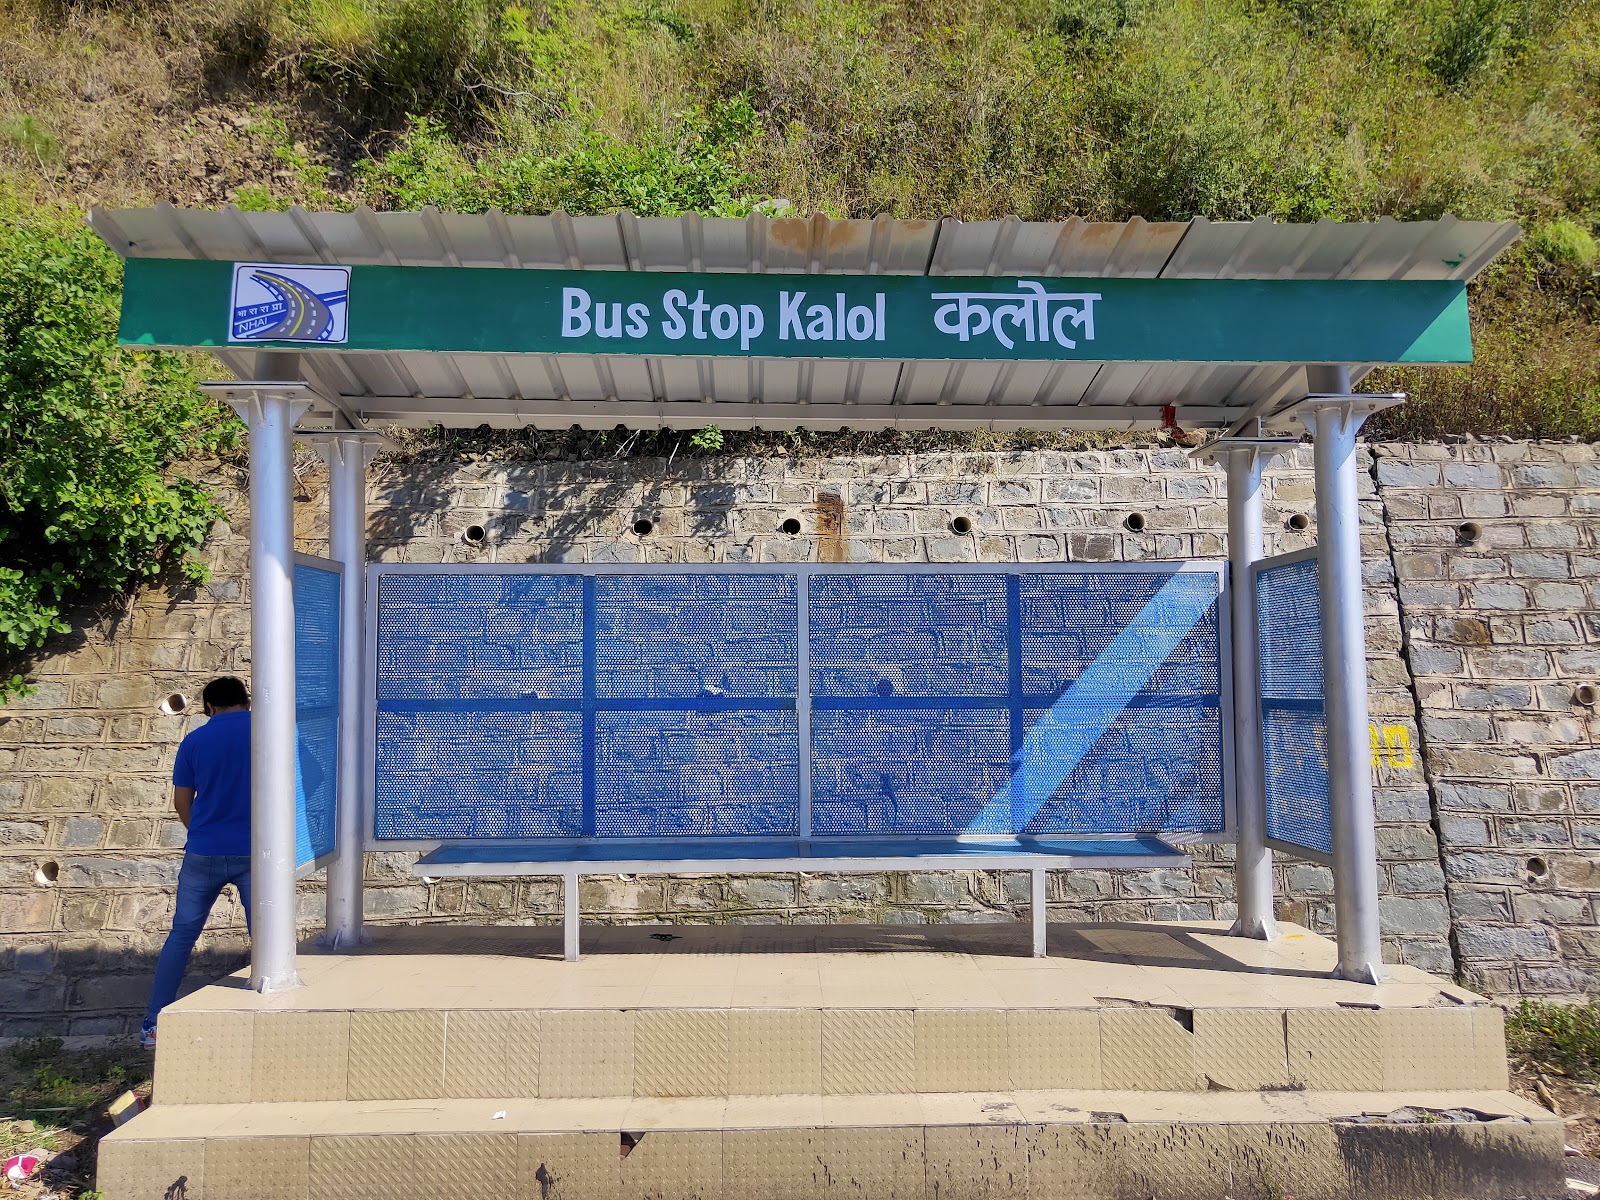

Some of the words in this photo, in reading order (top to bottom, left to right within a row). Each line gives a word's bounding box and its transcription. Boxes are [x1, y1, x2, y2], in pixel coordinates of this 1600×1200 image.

[239, 317, 268, 333] NHAI
[561, 287, 650, 339] Bus
[661, 289, 764, 351] Stop
[779, 291, 886, 341] Kalol
[931, 279, 1102, 350] कलोल
